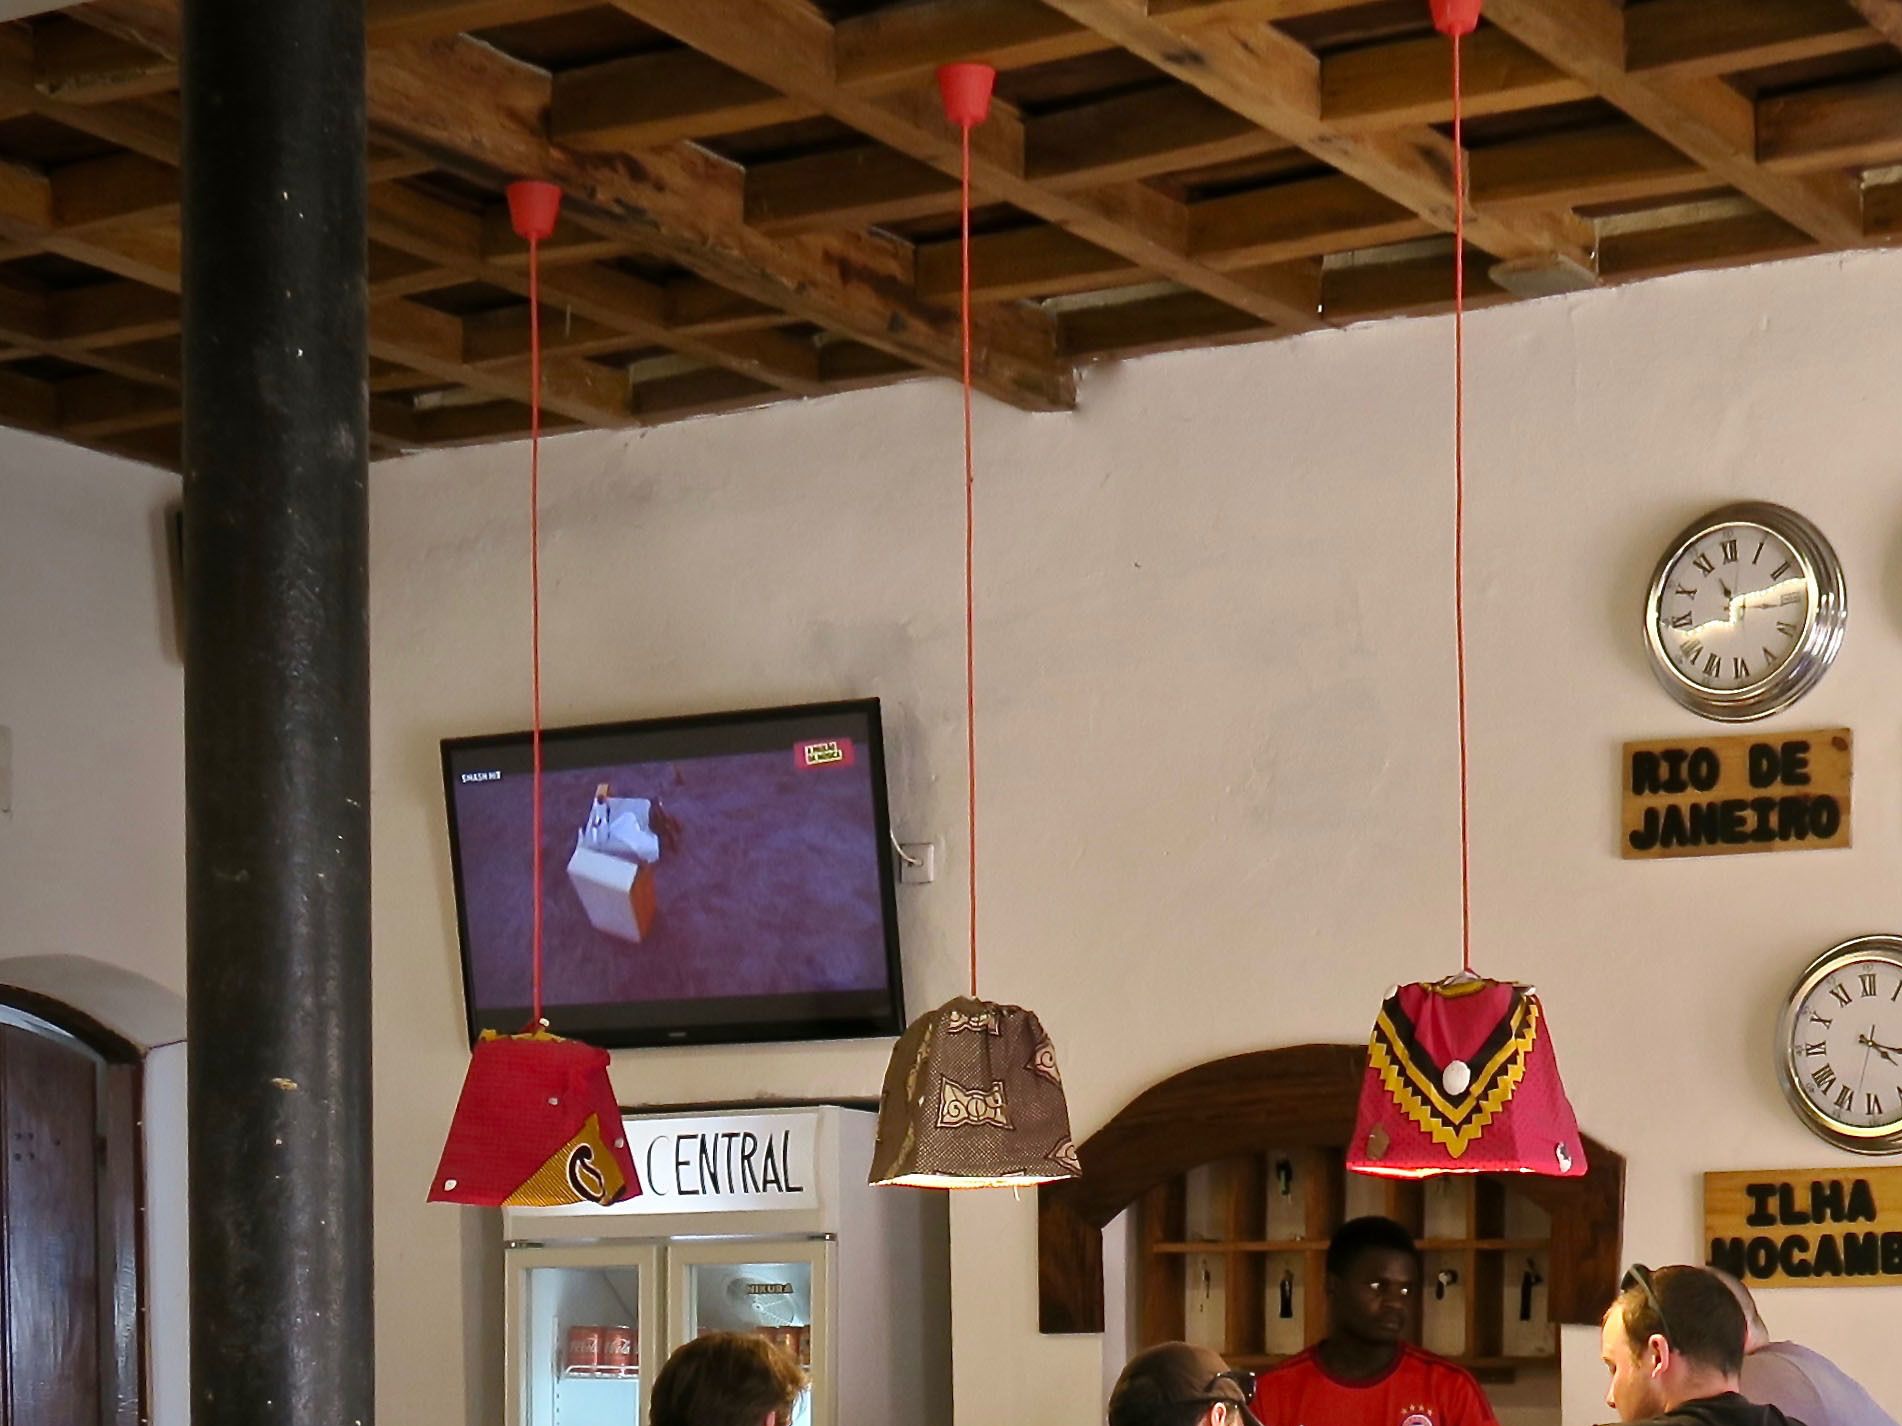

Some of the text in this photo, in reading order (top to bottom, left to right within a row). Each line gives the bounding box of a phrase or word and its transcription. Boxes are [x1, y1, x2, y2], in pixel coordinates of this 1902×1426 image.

[1631, 740, 1811, 795] RIO DE
[1629, 794, 1840, 850] JANEIRO
[646, 1130, 804, 1196] CENTRAL
[1746, 1178, 1877, 1227] ILHA
